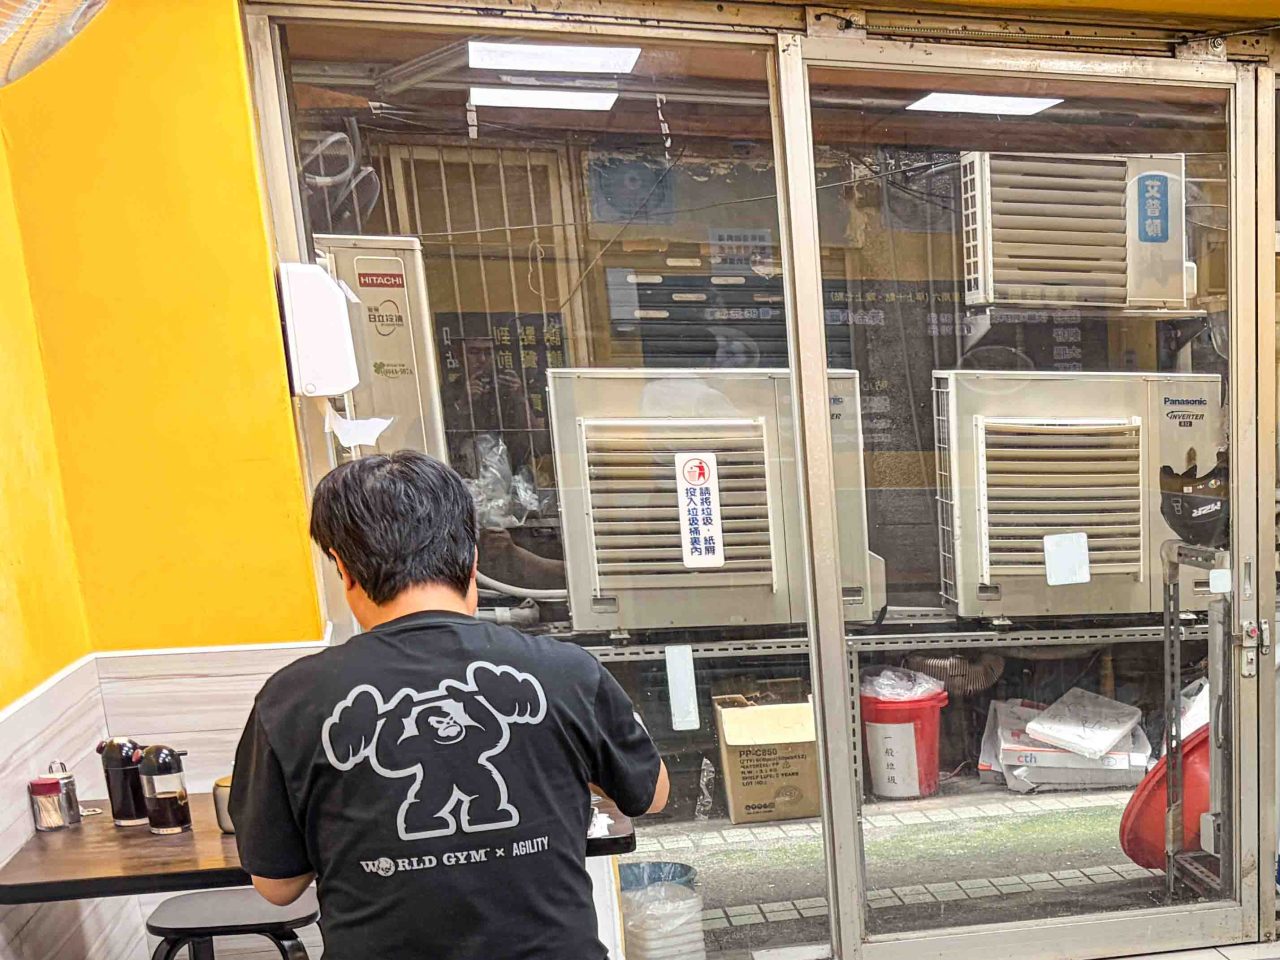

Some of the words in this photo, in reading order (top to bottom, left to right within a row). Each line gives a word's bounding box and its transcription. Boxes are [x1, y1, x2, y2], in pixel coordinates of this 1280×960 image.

[360, 276, 403, 286] HITACHI
[1163, 397, 1207, 406] Panasonic
[739, 748, 777, 758] PP-C850
[884, 736, 898, 785] 一般垃圾
[1017, 753, 1037, 765] cth
[442, 849, 487, 866] GYM
[512, 836, 550, 857] AGILITY
